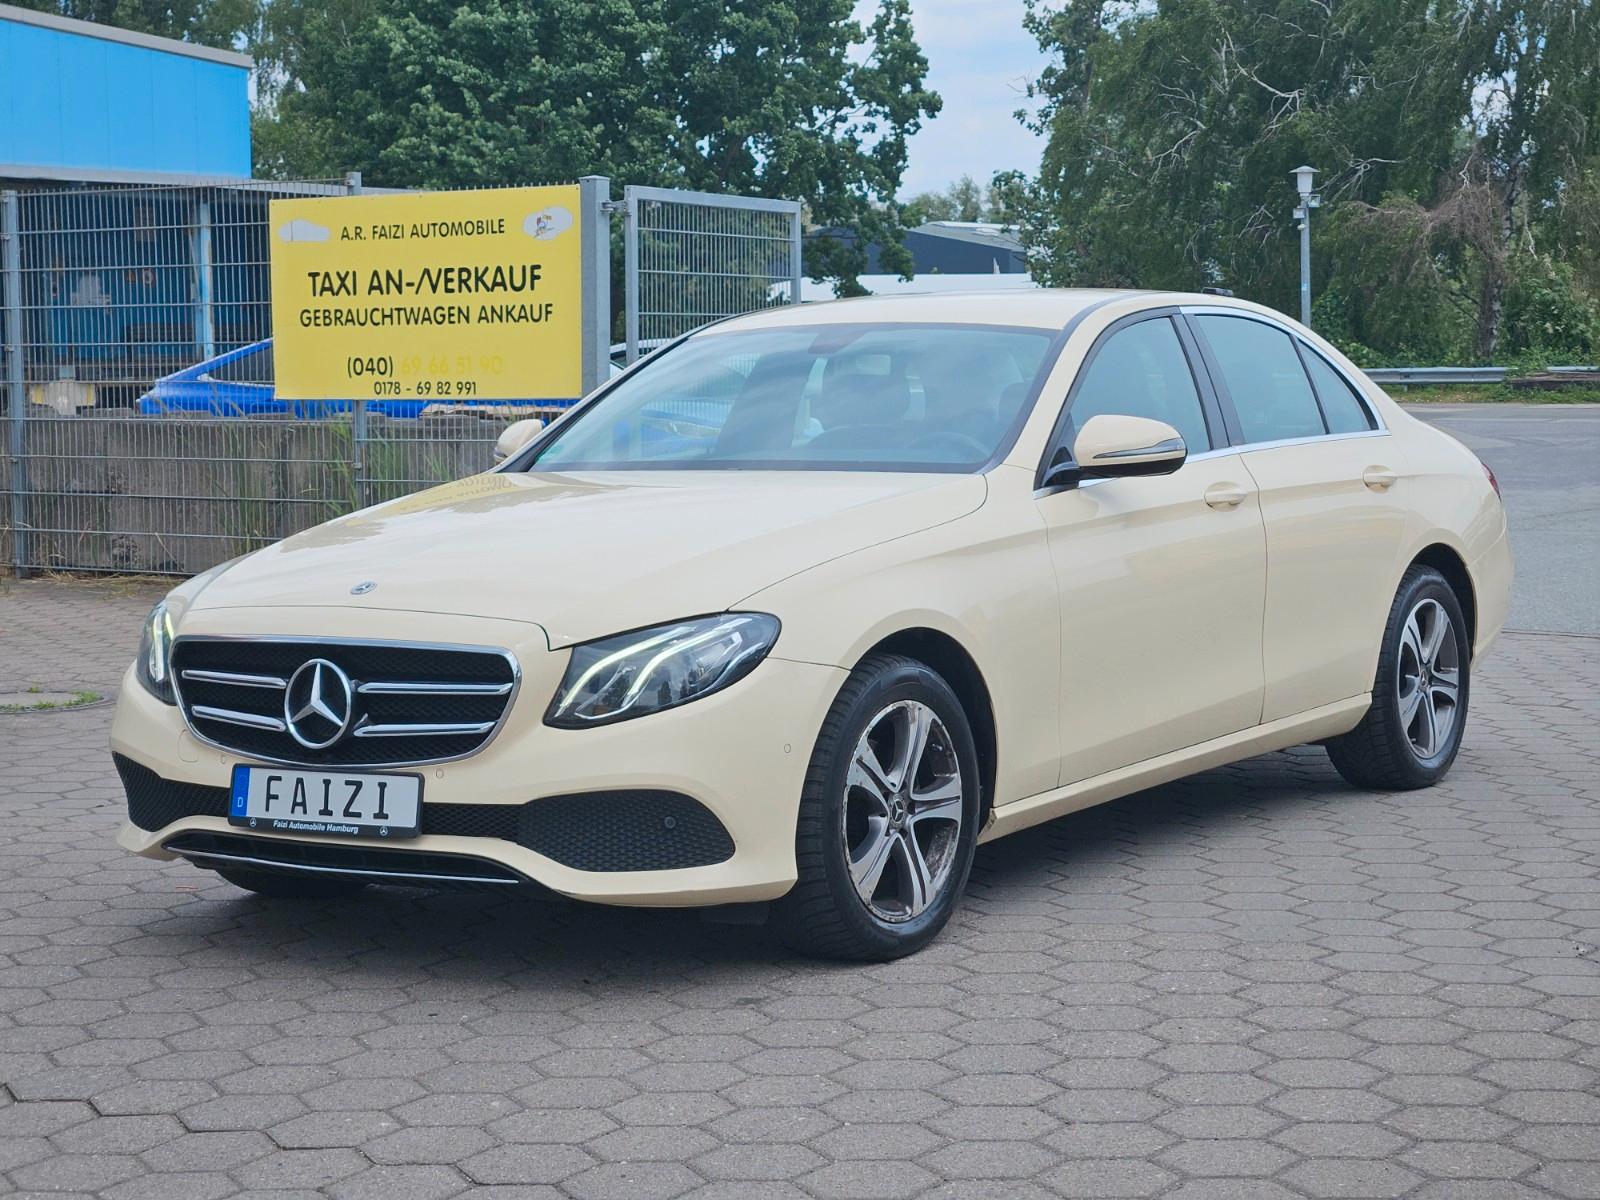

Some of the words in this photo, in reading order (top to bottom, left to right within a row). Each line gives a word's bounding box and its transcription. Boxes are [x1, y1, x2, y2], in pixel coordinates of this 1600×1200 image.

[341, 225, 366, 241] A.R.
[372, 224, 405, 240] FAIZI
[410, 219, 505, 238] AUTOMOBILE
[308, 270, 357, 297] TAXI
[368, 264, 542, 295] AN-/VERKAUF
[300, 306, 471, 328] GEBRAUCHTWAGEN
[477, 303, 554, 324] ANKAUF
[347, 356, 394, 378] (040)
[402, 356, 422, 375] 69
[374, 381, 401, 396] 0178
[416, 381, 431, 395] 69
[436, 381, 451, 395] 82
[456, 381, 477, 395] 991
[237, 796, 244, 808] D
[264, 775, 389, 820] FAIZI
[273, 819, 288, 829] Faizi
[288, 821, 326, 832] Automobile
[326, 824, 359, 835] Hamburg
